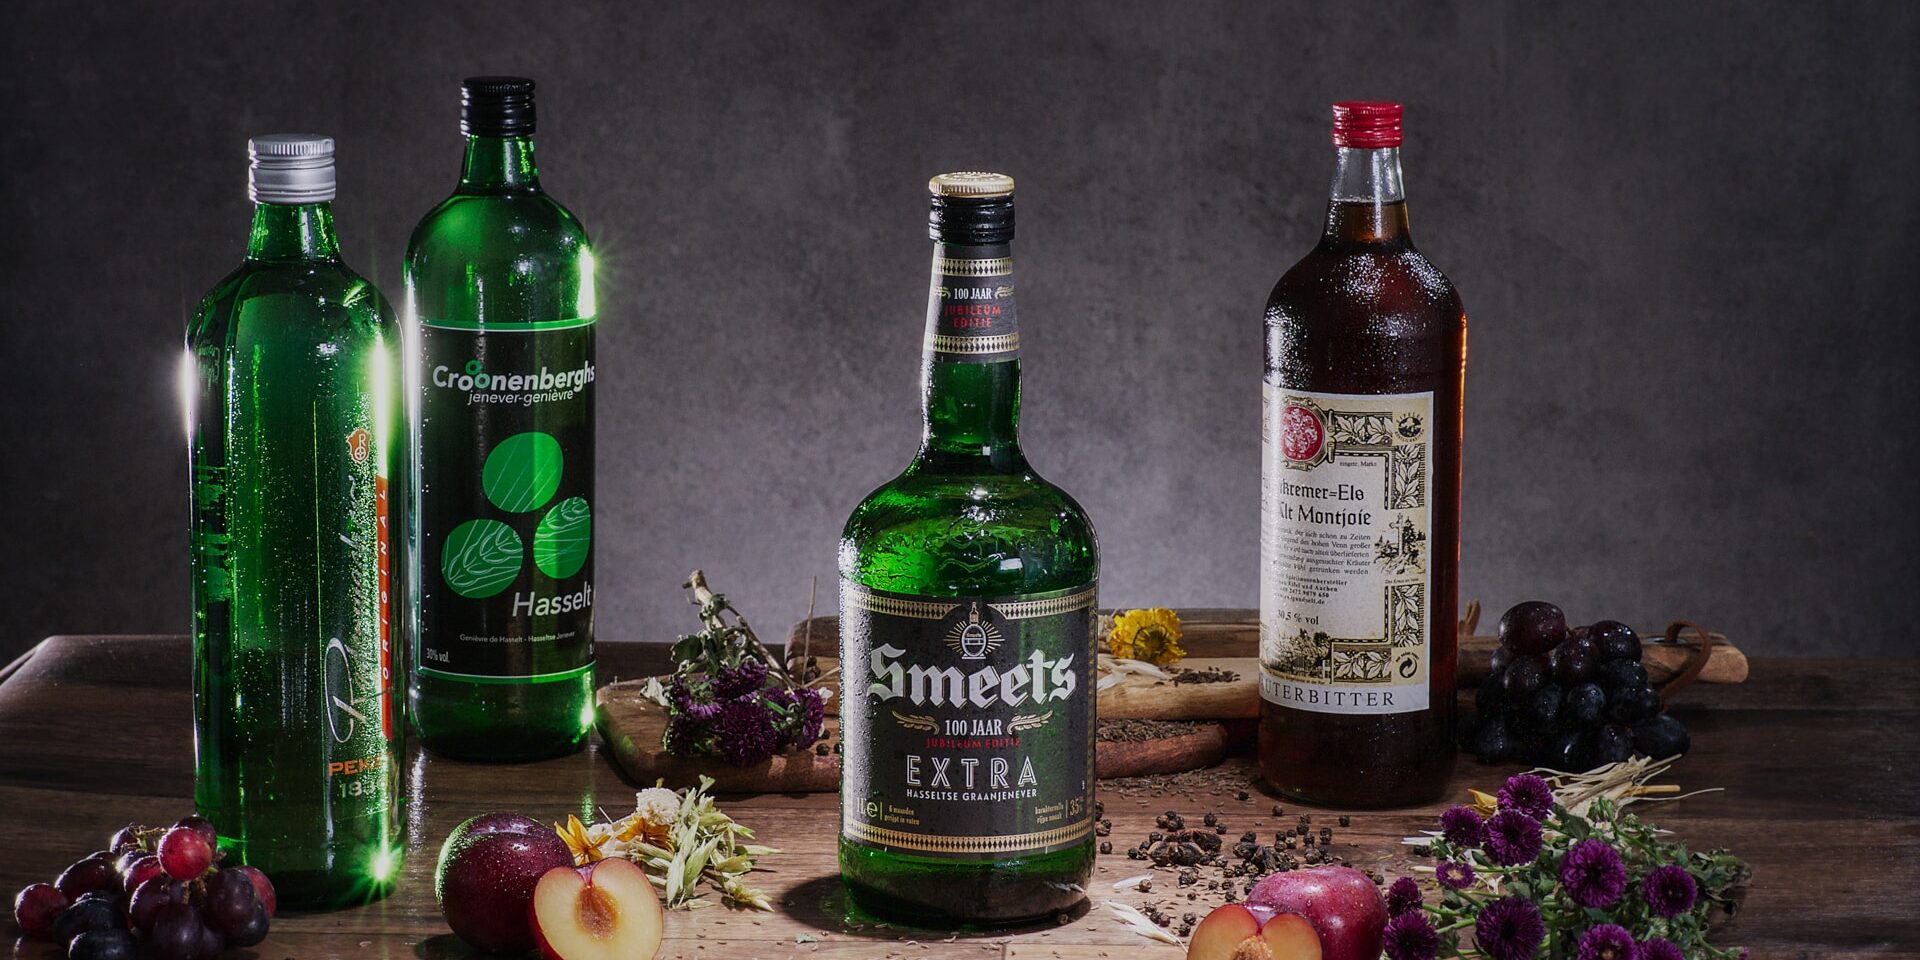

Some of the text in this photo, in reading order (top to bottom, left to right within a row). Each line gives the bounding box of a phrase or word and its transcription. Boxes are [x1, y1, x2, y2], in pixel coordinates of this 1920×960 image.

[954, 288, 992, 300] 100 JAAR
[943, 304, 1001, 316] JUBILEUM
[953, 318, 992, 328] EDITIE
[432, 360, 595, 392] Croonenberghs
[467, 389, 573, 407] jenever-genièvre
[1298, 505, 1371, 528] Montjoie
[1344, 567, 1369, 575] werden
[379, 489, 390, 681] ORIGINAL
[512, 581, 592, 617] Hasselt
[1305, 616, 1319, 625] vol
[866, 643, 1077, 709] Smeets
[945, 719, 1002, 736] 100 JAAR
[926, 738, 1020, 749] JUBILEUM EDITIE
[907, 755, 1037, 789] EXTRA
[906, 789, 1037, 802] HASSELTSE GRAANJENEVER
